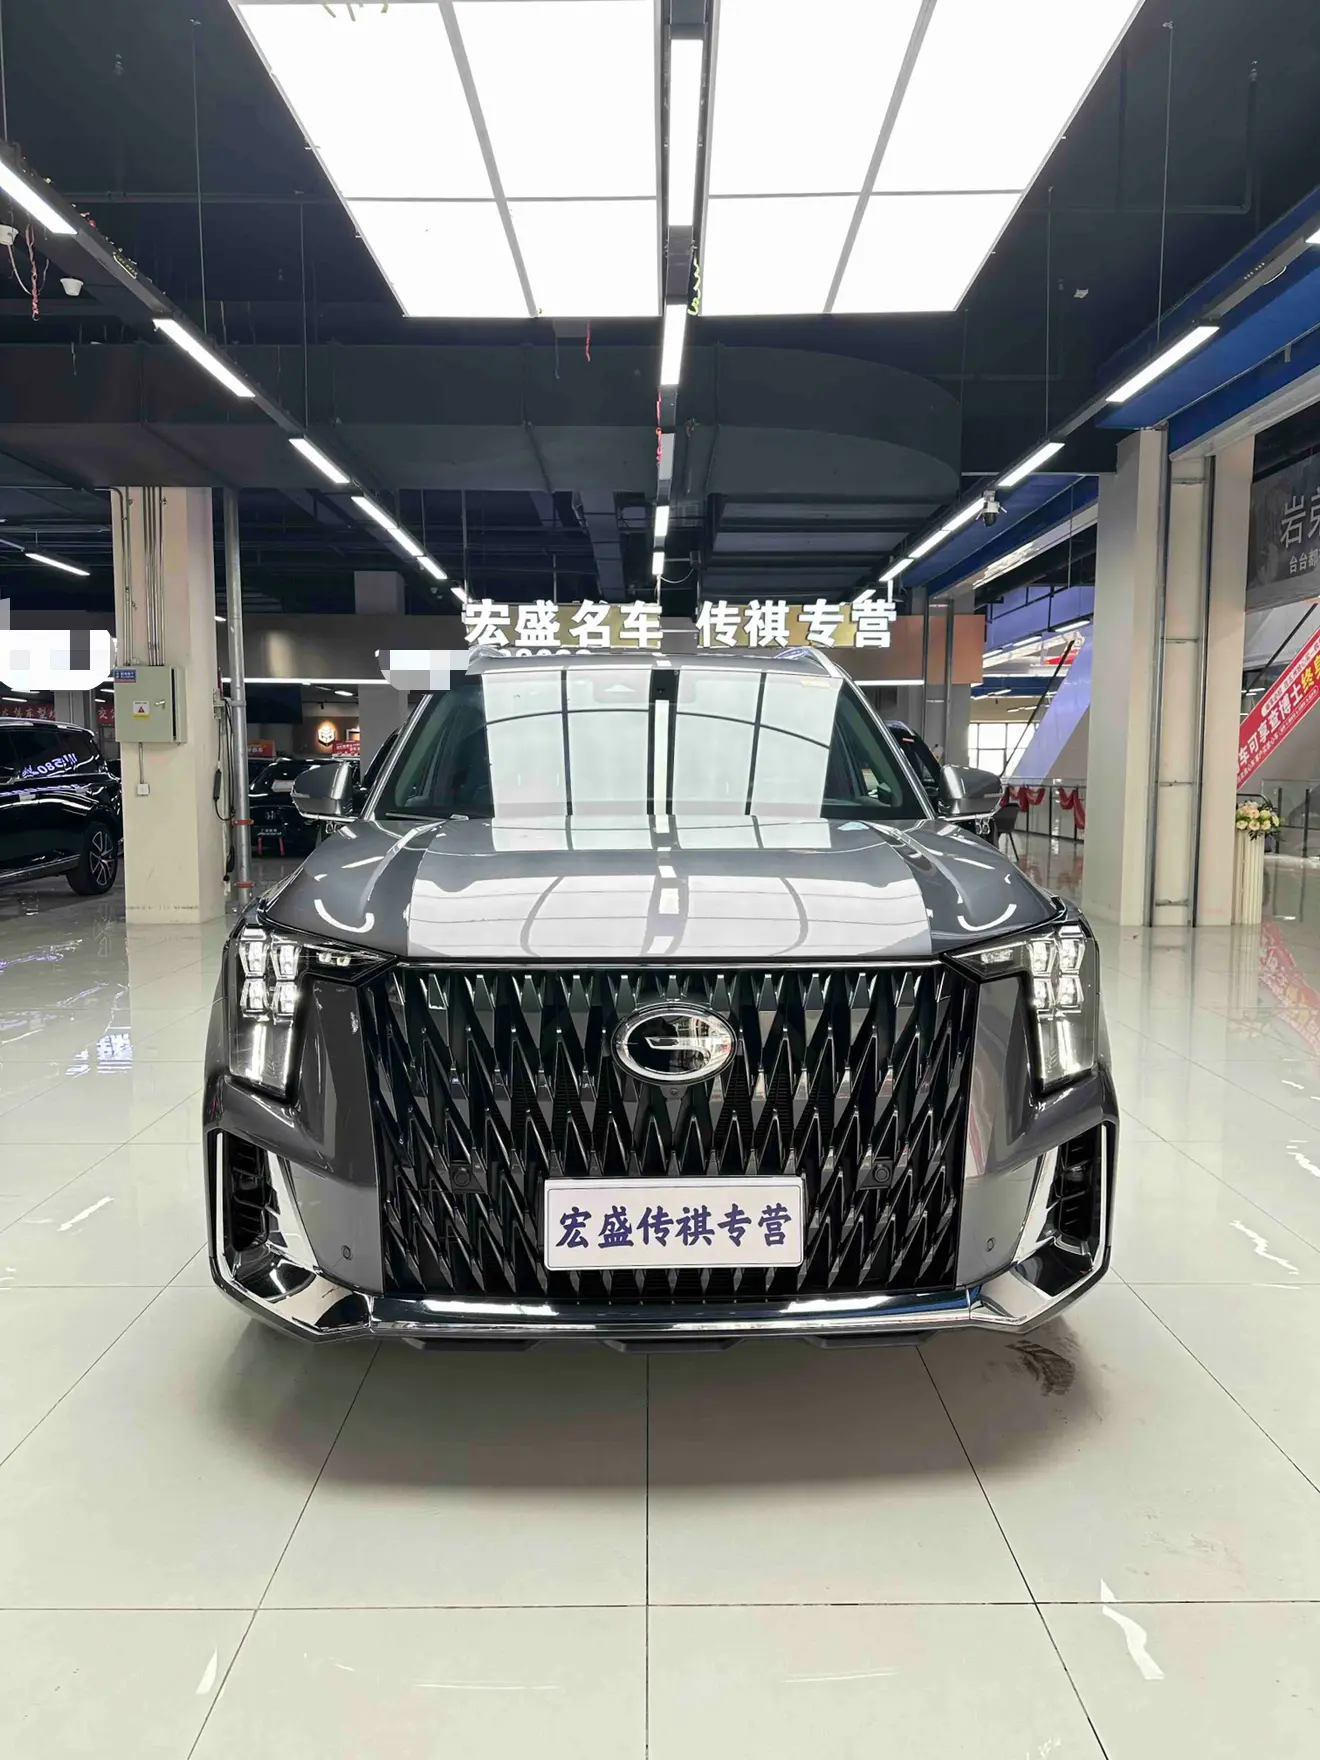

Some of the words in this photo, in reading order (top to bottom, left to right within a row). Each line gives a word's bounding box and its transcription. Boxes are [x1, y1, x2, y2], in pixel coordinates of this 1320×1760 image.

[1289, 548, 1320, 574] 台台都
[464, 599, 663, 648] 宏盛名车
[696, 598, 897, 648] 传祺专营
[1237, 653, 1320, 774] 车可享查博士终
[555, 1202, 792, 1249] 宏盛传祺专营
